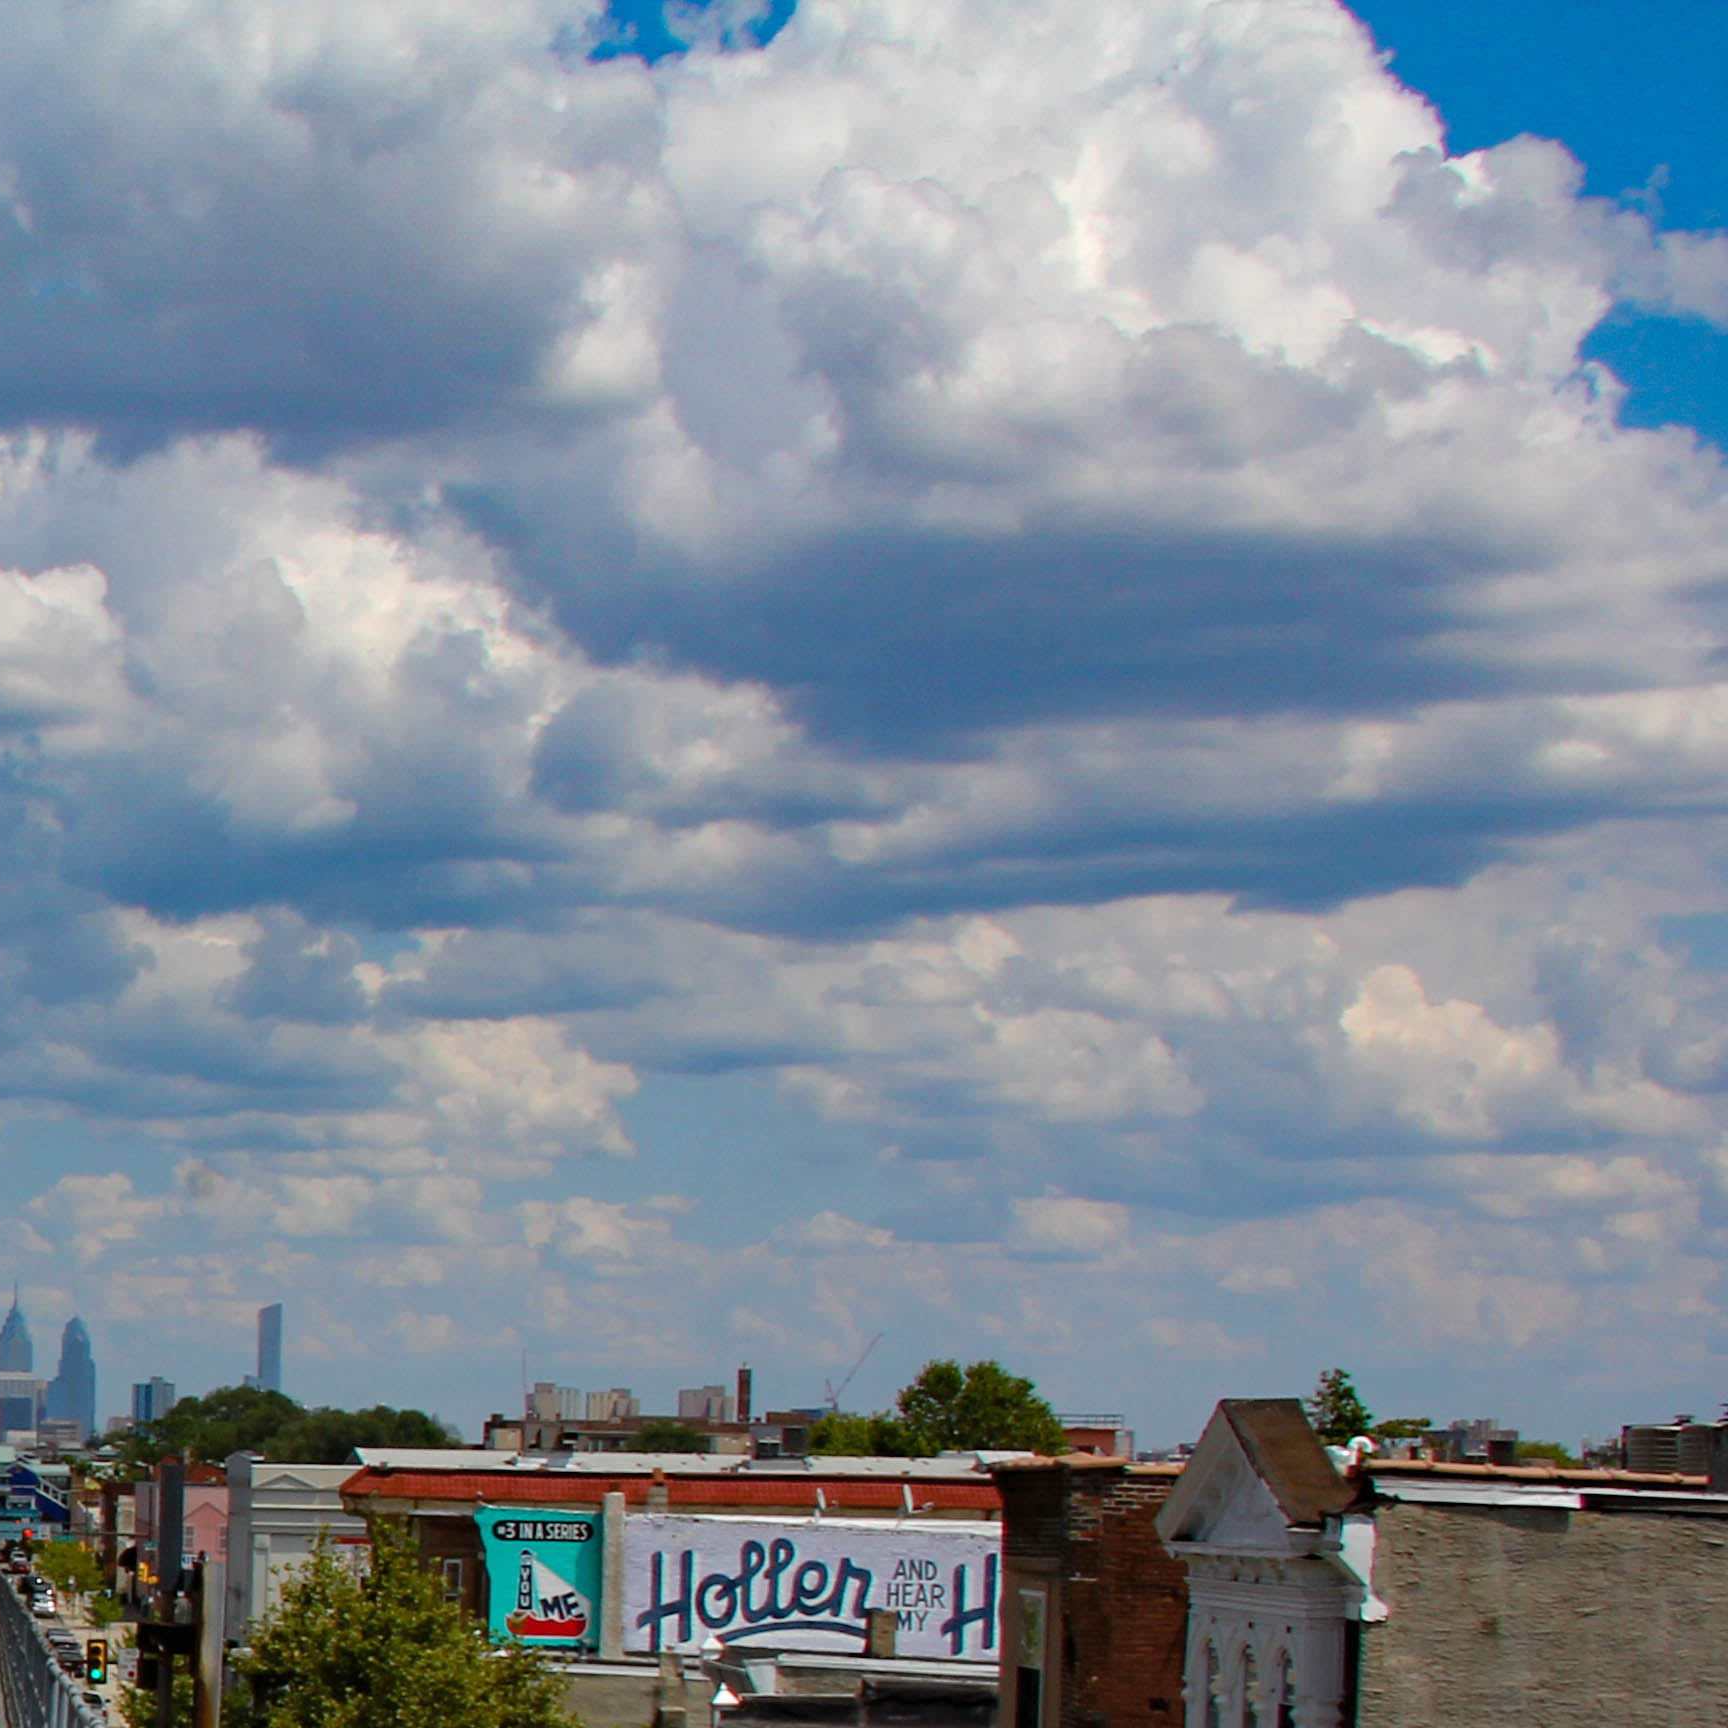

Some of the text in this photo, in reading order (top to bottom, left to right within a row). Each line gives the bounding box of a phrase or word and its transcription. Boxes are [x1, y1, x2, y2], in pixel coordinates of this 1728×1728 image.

[519, 1522, 534, 1539] IN
[535, 1522, 545, 1539] A
[545, 1523, 588, 1540] SERIES
[894, 1559, 938, 1580] AND
[519, 1566, 531, 1608] YOU
[636, 1538, 880, 1651] Holler
[886, 1583, 945, 1609] HEAR
[539, 1592, 585, 1620] ME
[895, 1611, 929, 1632] MY
